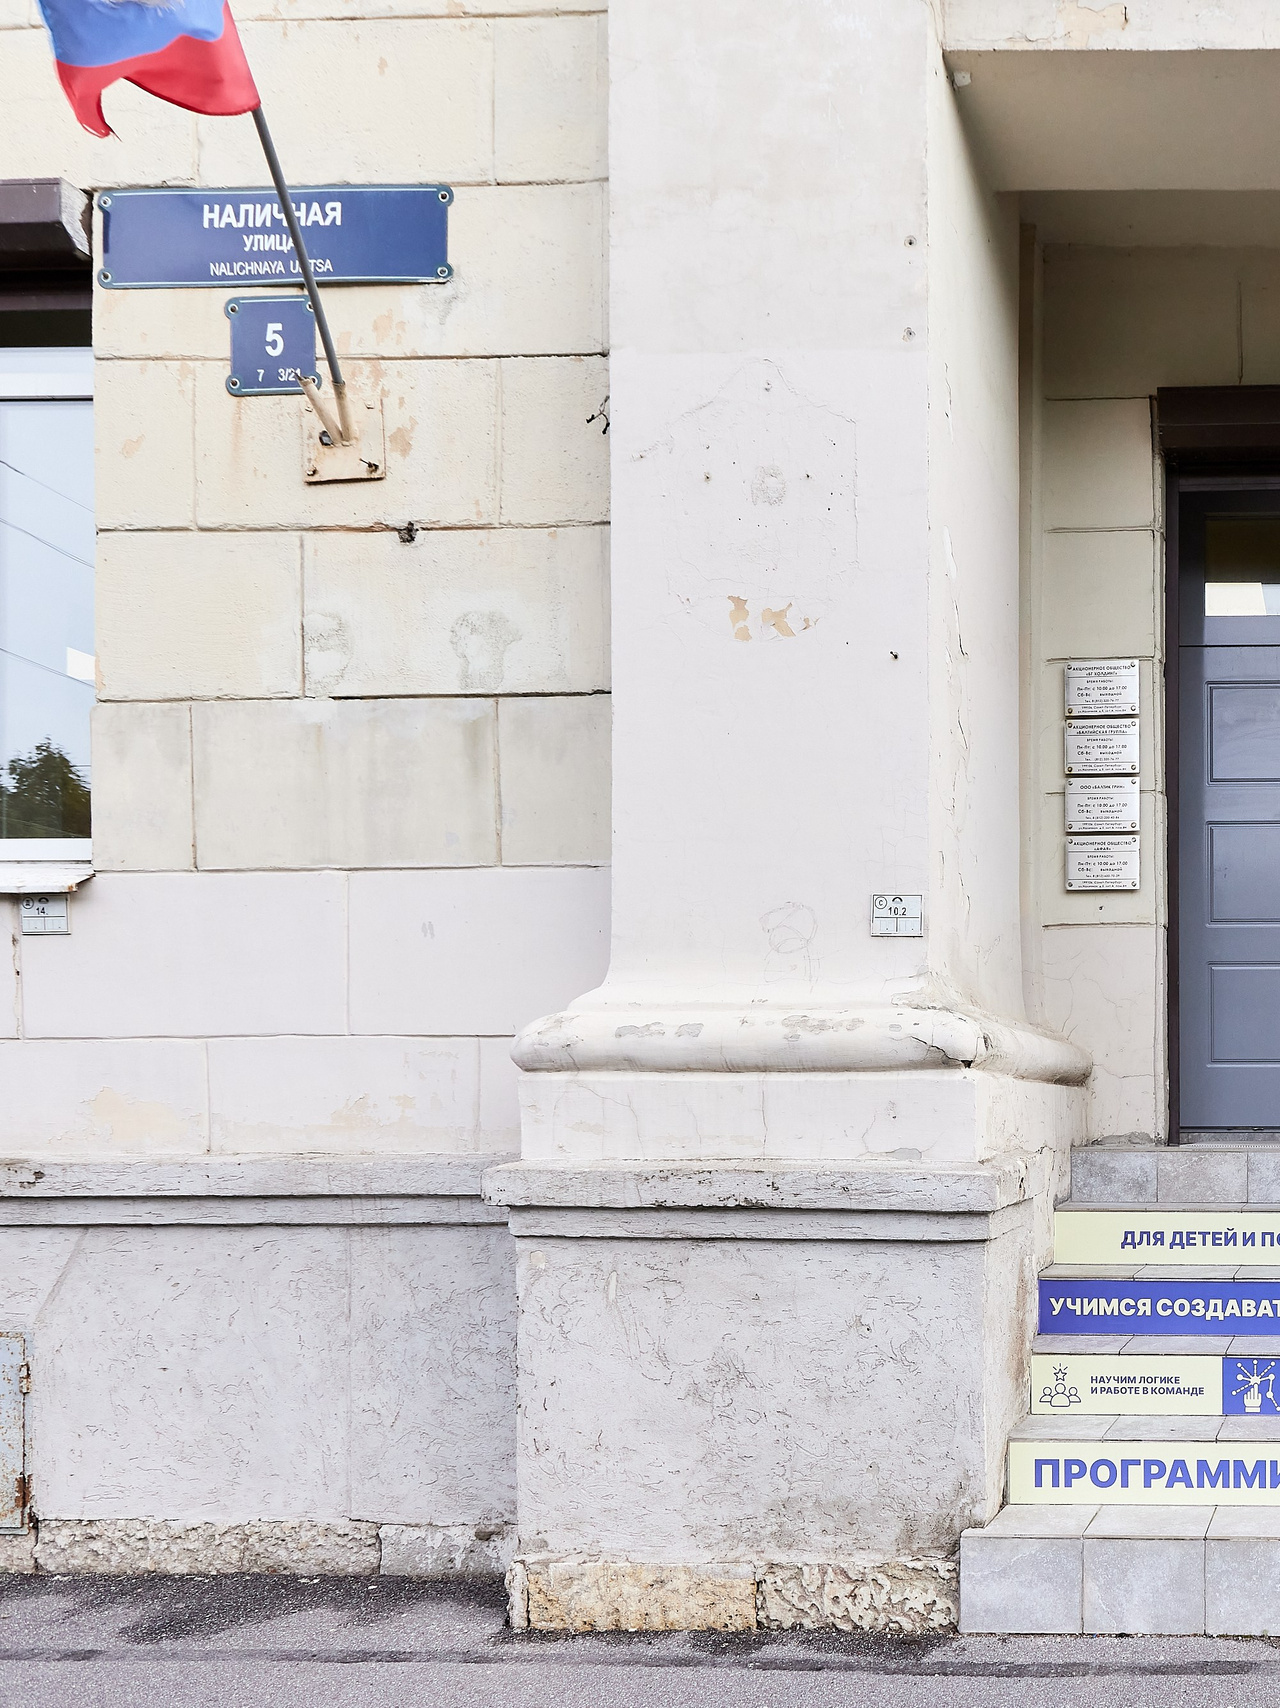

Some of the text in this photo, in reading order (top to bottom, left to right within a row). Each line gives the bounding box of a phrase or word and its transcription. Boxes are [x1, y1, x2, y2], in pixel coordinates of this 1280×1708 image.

[203, 201, 342, 229] НАЛИЧНАЯ
[210, 260, 286, 276] NALICHNAYA
[265, 322, 284, 357] 5
[256, 369, 265, 382] 7
[888, 907, 907, 916] 10.2
[1121, 1231, 1165, 1249] ДЛЯ
[1169, 1228, 1237, 1249] ДЕТЕЙ
[1242, 1232, 1256, 1246] И
[1050, 1297, 1152, 1316] УЧИМСЯ
[1090, 1376, 1180, 1384] НАУЧИМ ЛОГИКЕ
[1151, 1387, 1204, 1396] КОМАНДЕ
